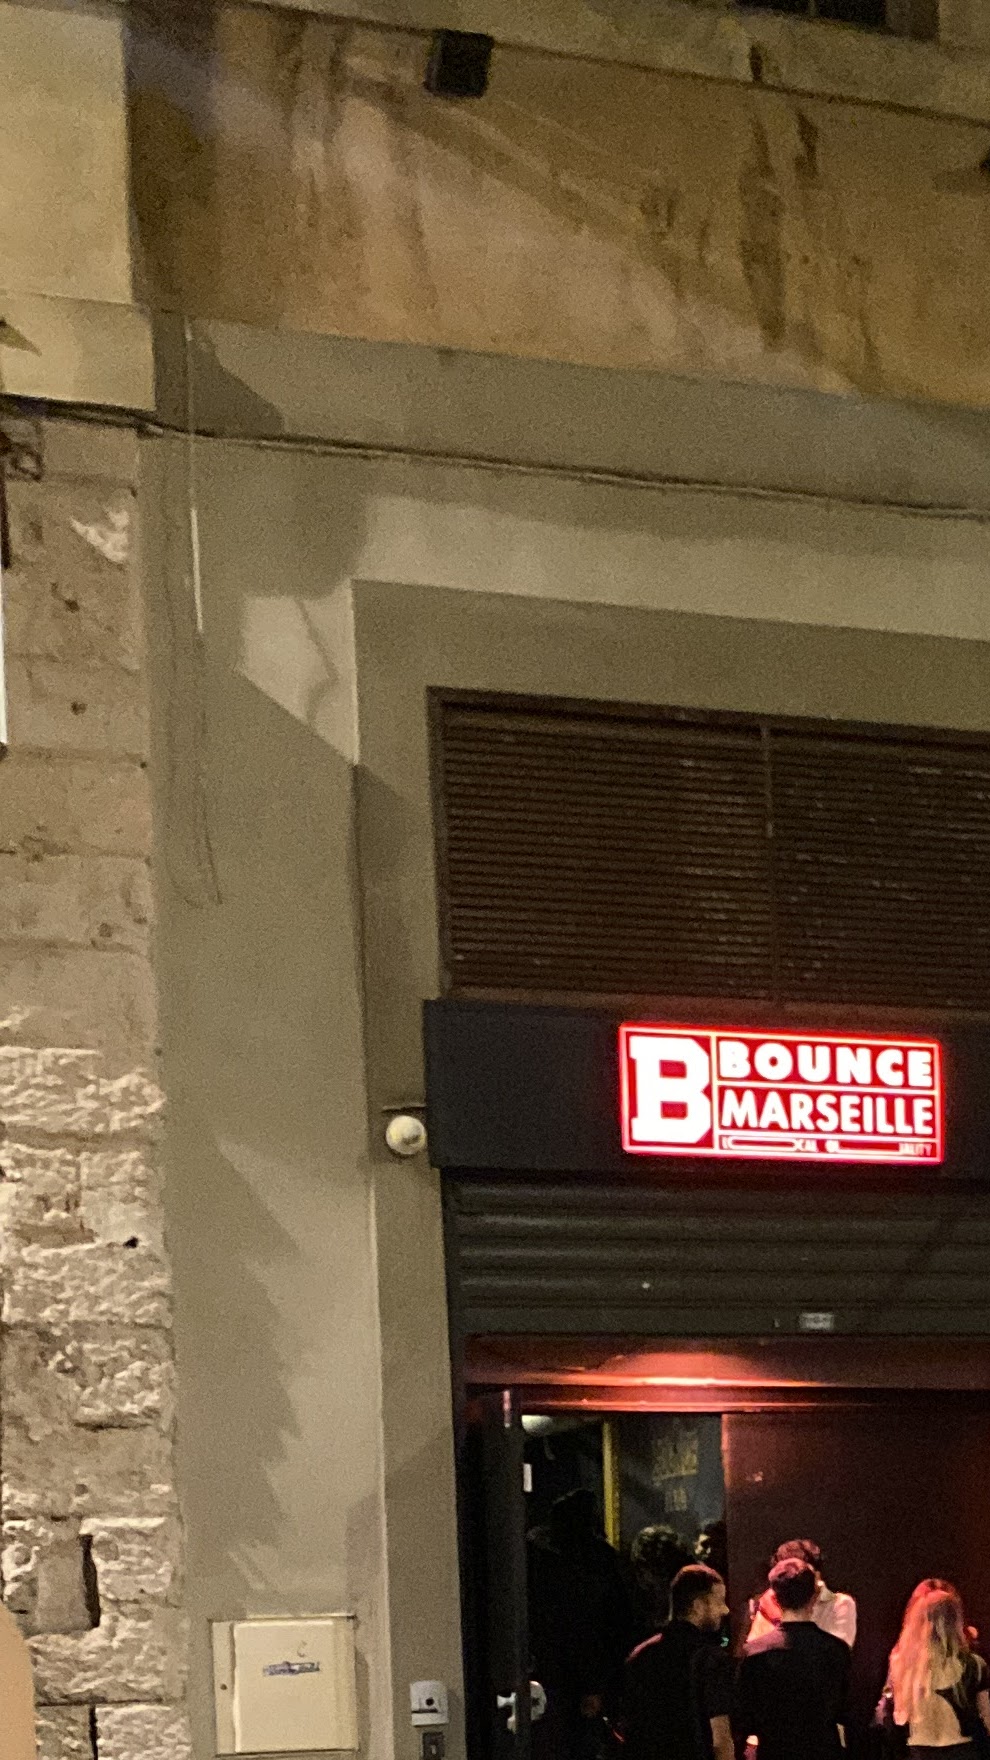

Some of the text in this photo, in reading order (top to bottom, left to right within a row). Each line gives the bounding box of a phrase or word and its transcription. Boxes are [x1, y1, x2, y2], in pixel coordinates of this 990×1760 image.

[719, 1040, 933, 1087] BOUNCE
[629, 1035, 711, 1144] B
[720, 1089, 934, 1135] MARSEILLE
